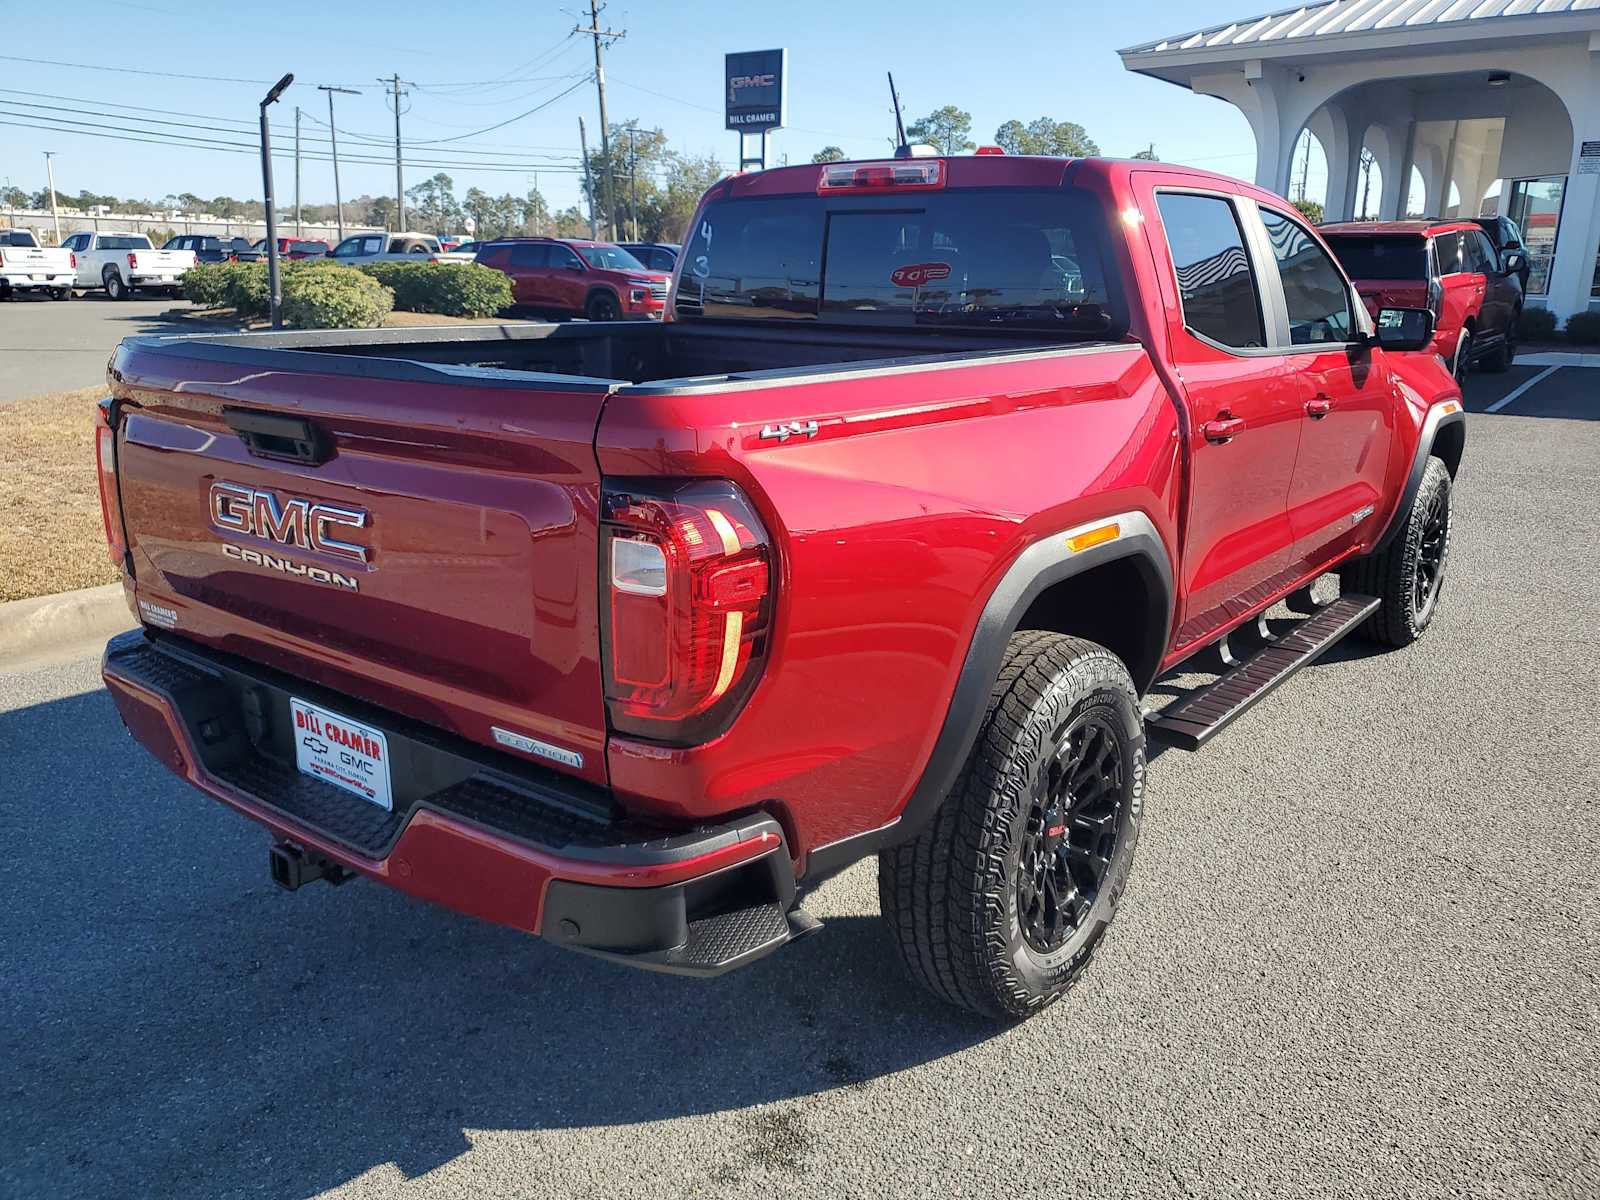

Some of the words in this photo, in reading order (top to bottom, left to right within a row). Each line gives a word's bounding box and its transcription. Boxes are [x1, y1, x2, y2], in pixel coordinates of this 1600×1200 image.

[730, 75, 776, 88] GMC
[729, 115, 745, 124] BILL
[746, 113, 776, 123] CRAMER
[209, 481, 367, 561] GMC
[222, 543, 359, 592] CANYON
[296, 710, 322, 736] BILL
[325, 722, 382, 761] CRAMER
[498, 734, 573, 765] ELEVATION
[314, 756, 334, 768] PANAMA
[348, 770, 368, 783] FLORIDA
[340, 751, 374, 776] GMC
